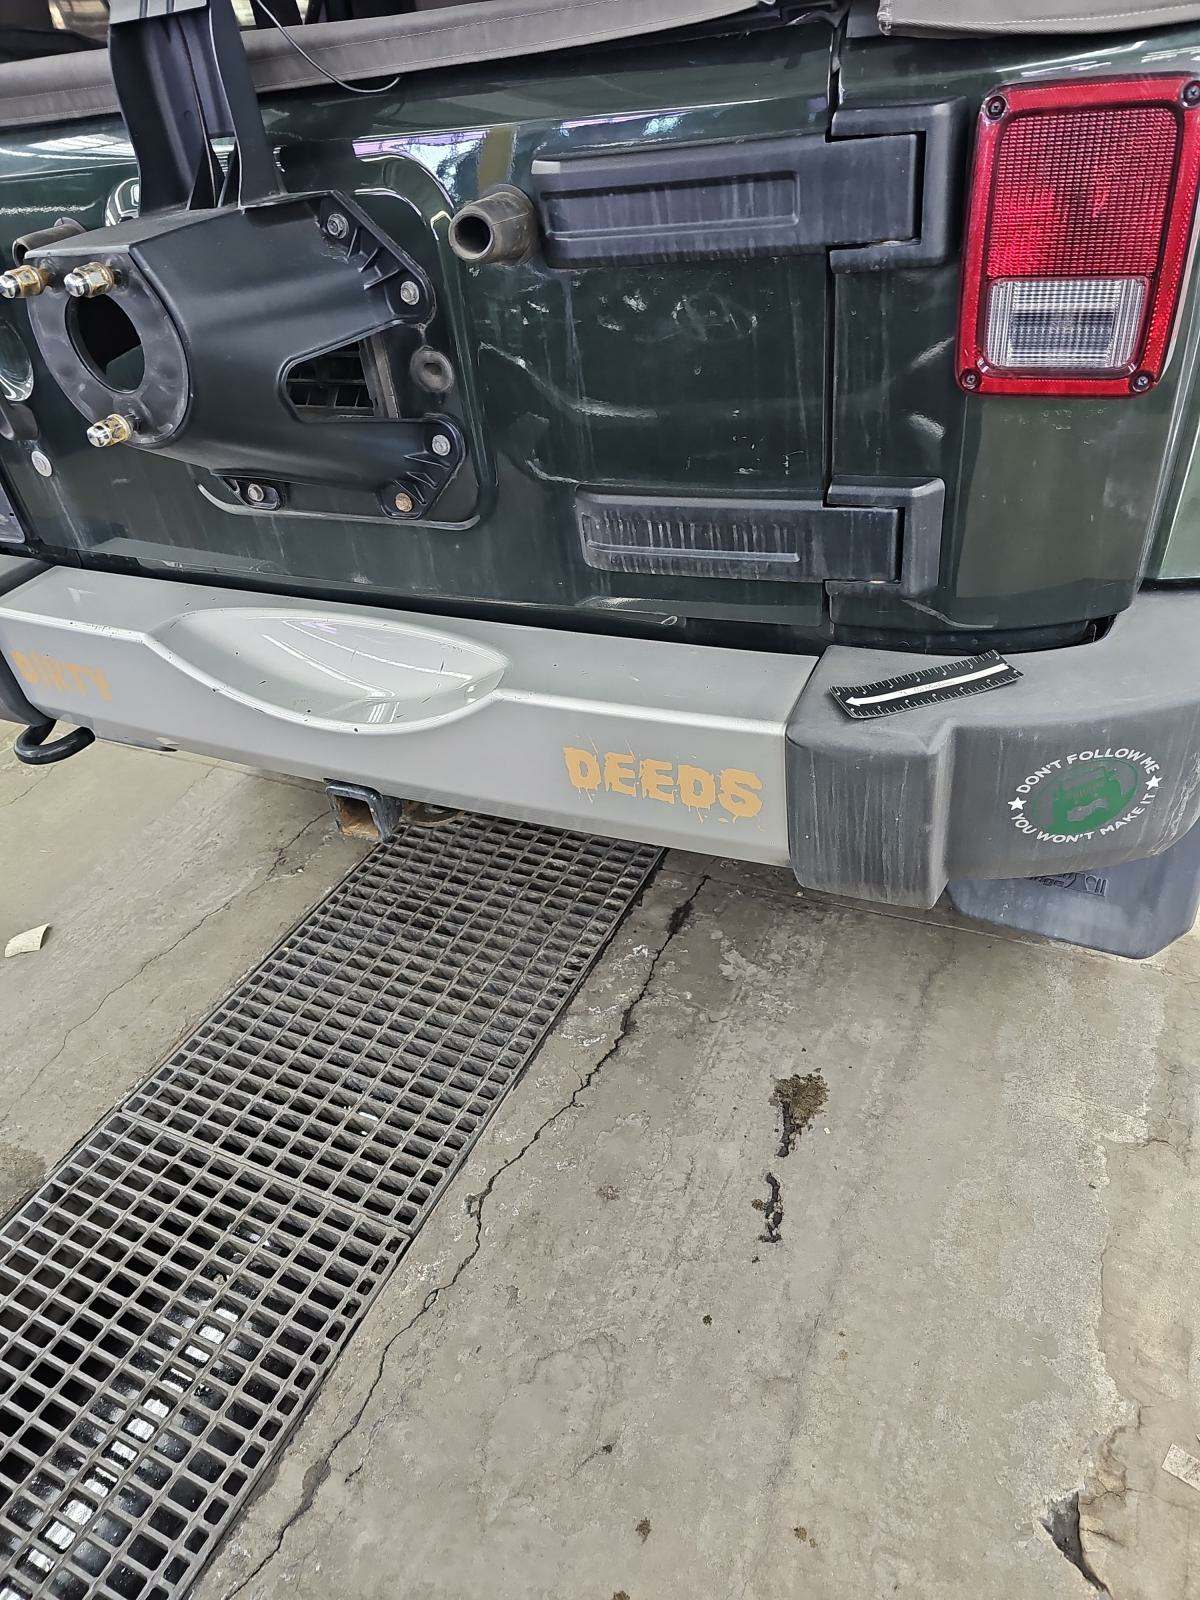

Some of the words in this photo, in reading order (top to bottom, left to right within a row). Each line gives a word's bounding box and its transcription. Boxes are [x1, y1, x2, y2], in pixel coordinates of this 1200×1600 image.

[562, 744, 763, 822] DEEDS
[1016, 759, 1062, 794] DON'T
[1066, 748, 1146, 765] FOLLOW
[1139, 756, 1161, 775] ME
[1011, 812, 1037, 835] YOU
[1036, 830, 1095, 843] WON'T
[1100, 806, 1146, 835] MAKE
[1140, 792, 1156, 806] IT
